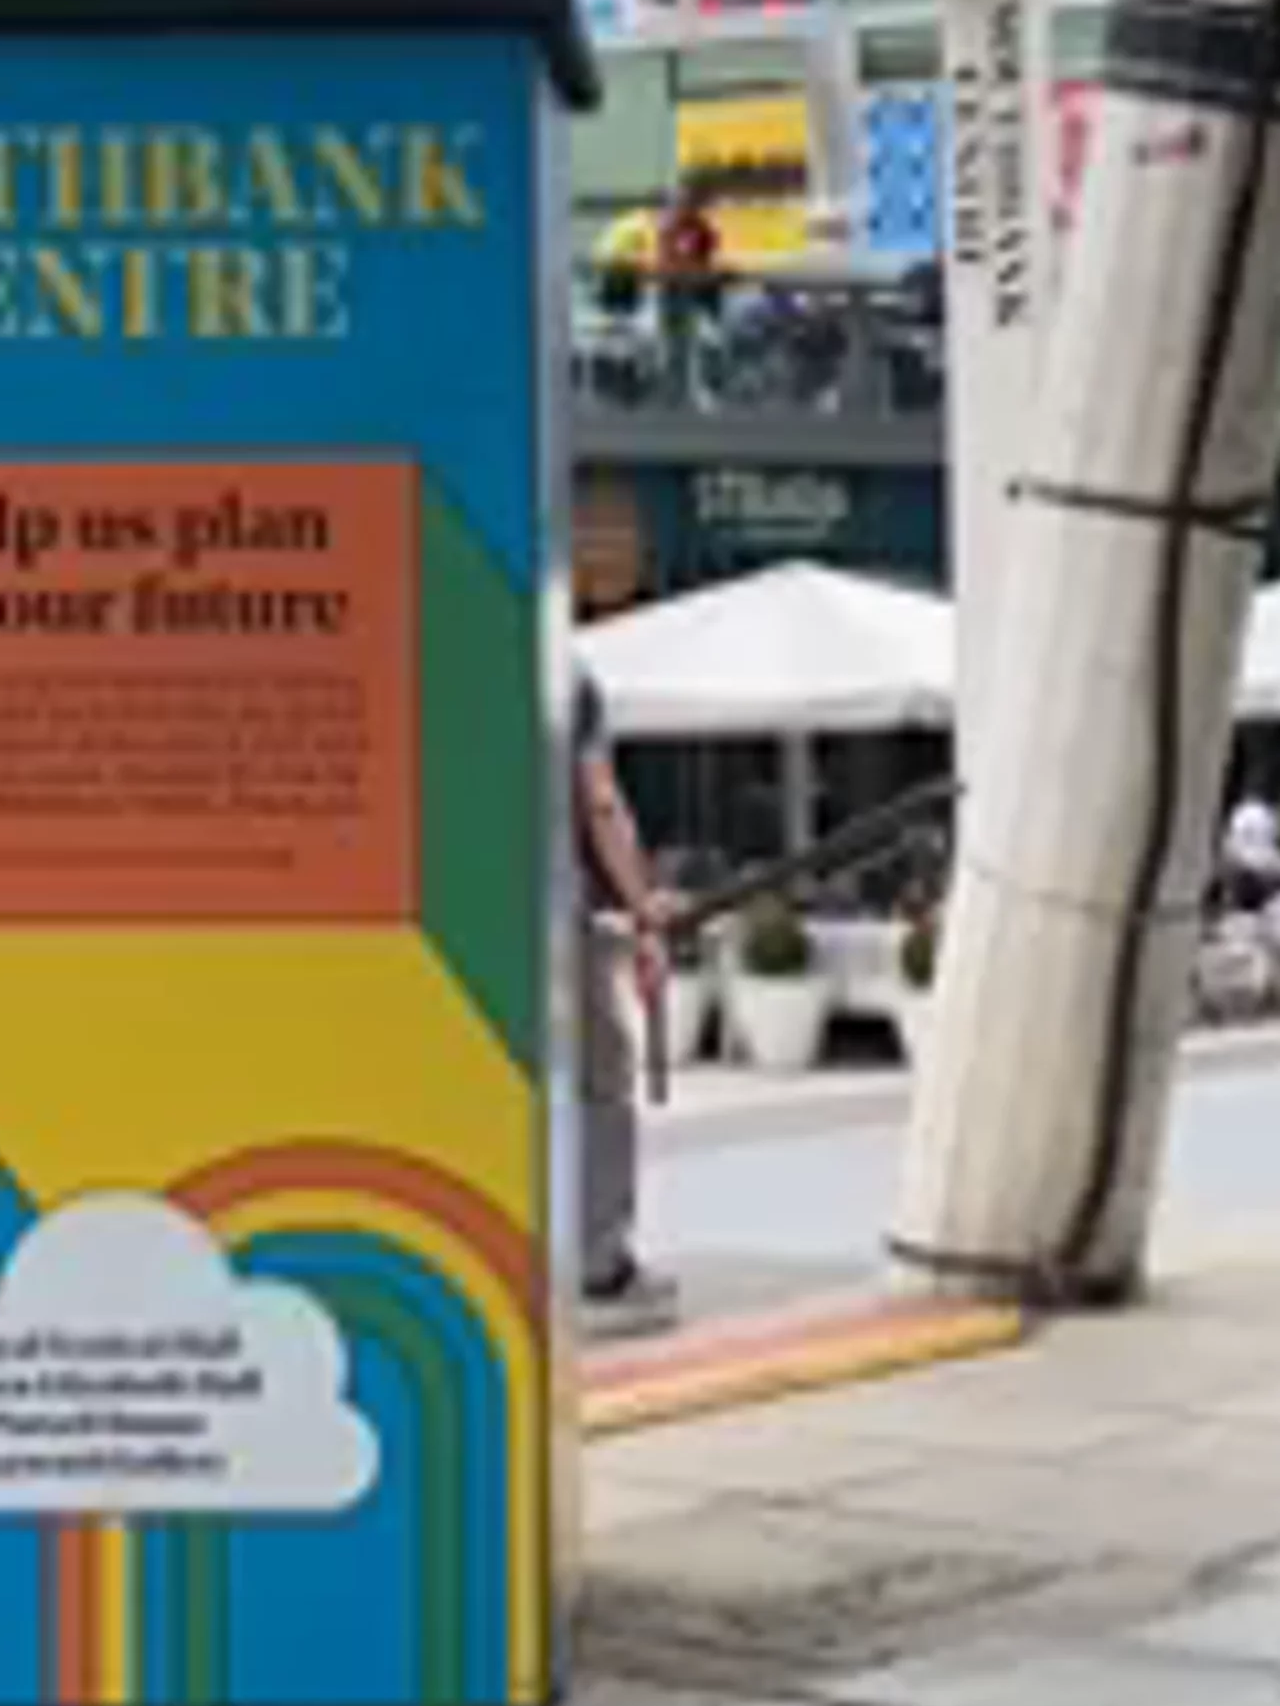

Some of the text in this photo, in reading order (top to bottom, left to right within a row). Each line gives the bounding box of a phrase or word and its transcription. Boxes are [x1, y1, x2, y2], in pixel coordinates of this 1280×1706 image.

[75, 506, 156, 551] us
[166, 491, 330, 571] plan
[130, 572, 350, 635] future
